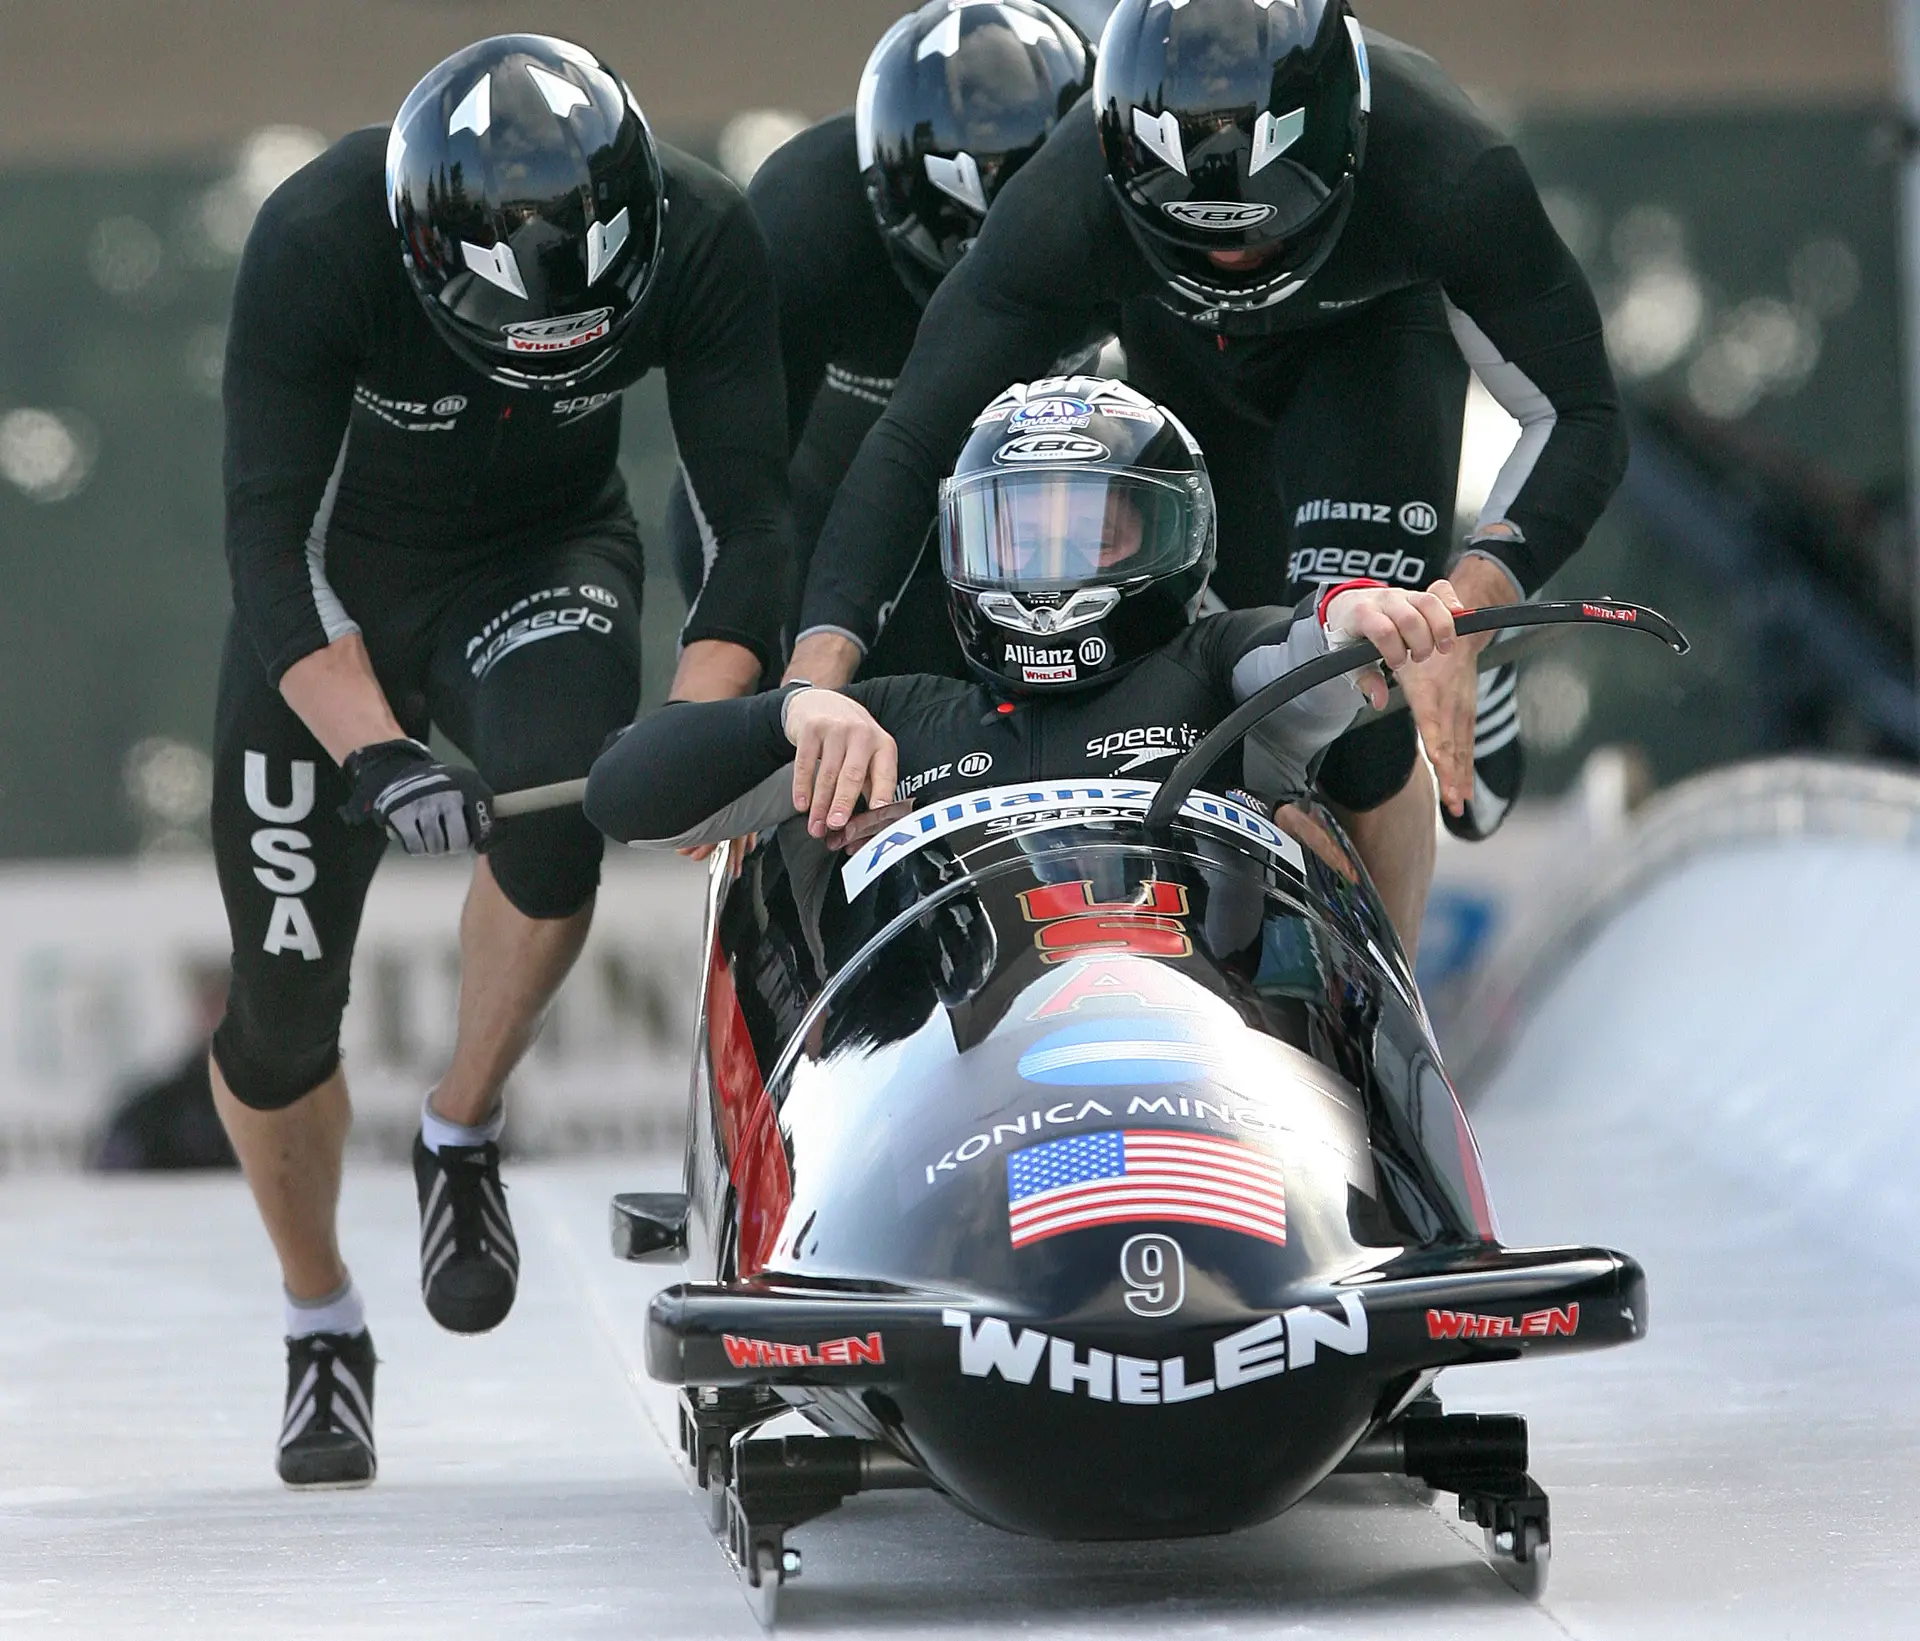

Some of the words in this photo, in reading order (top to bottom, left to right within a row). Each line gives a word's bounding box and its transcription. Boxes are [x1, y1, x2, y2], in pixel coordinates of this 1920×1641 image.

[1172, 206, 1267, 221] KBC
[512, 325, 603, 350] WHELEN
[1011, 416, 1088, 430] ADVOCARE
[1002, 440, 1099, 457] KBC
[1294, 499, 1392, 527] Allianz
[1286, 548, 1426, 584] speedo
[1004, 643, 1075, 665] Allianz
[1025, 668, 1073, 680] WHELEN
[893, 763, 953, 803] llianz
[864, 786, 1153, 874] Allianz
[244, 749, 323, 961] USA
[1015, 879, 1208, 1021] USA
[925, 1100, 1113, 1185] KONICA
[1126, 1093, 1296, 1134] MINO
[1119, 1232, 1186, 1319] 9
[1426, 1301, 1580, 1340] WHELEN
[721, 1331, 886, 1369] WHELEN
[942, 1290, 1370, 1405] WHELEN
